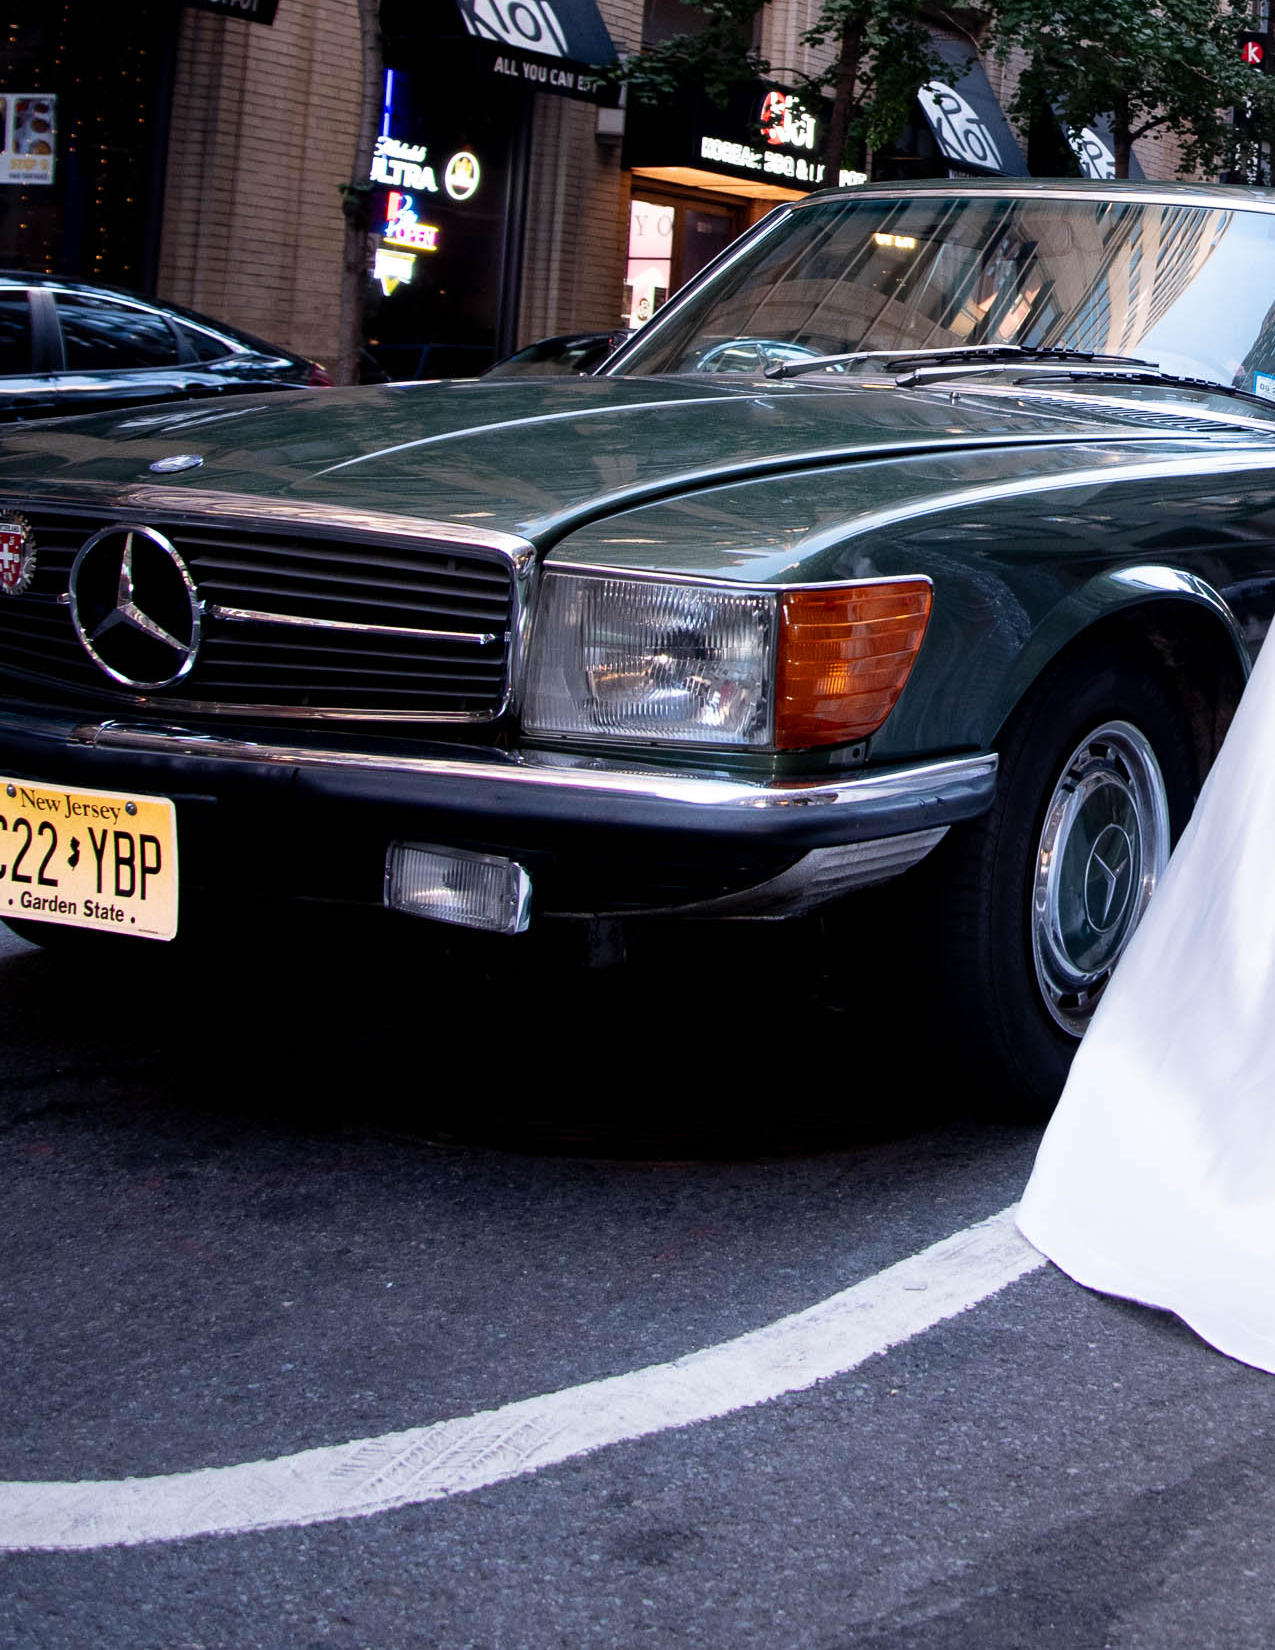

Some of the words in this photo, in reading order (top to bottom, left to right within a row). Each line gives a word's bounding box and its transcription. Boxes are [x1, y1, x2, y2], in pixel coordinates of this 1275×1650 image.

[493, 56, 519, 77] ALL
[521, 61, 548, 83] YOU
[549, 69, 575, 90] CAN
[395, 226, 436, 246] OPEN
[19, 788, 62, 813] New
[64, 794, 122, 825] Jersey
[87, 826, 162, 900] YBP
[20, 891, 77, 915] Garden
[83, 899, 125, 923] State
